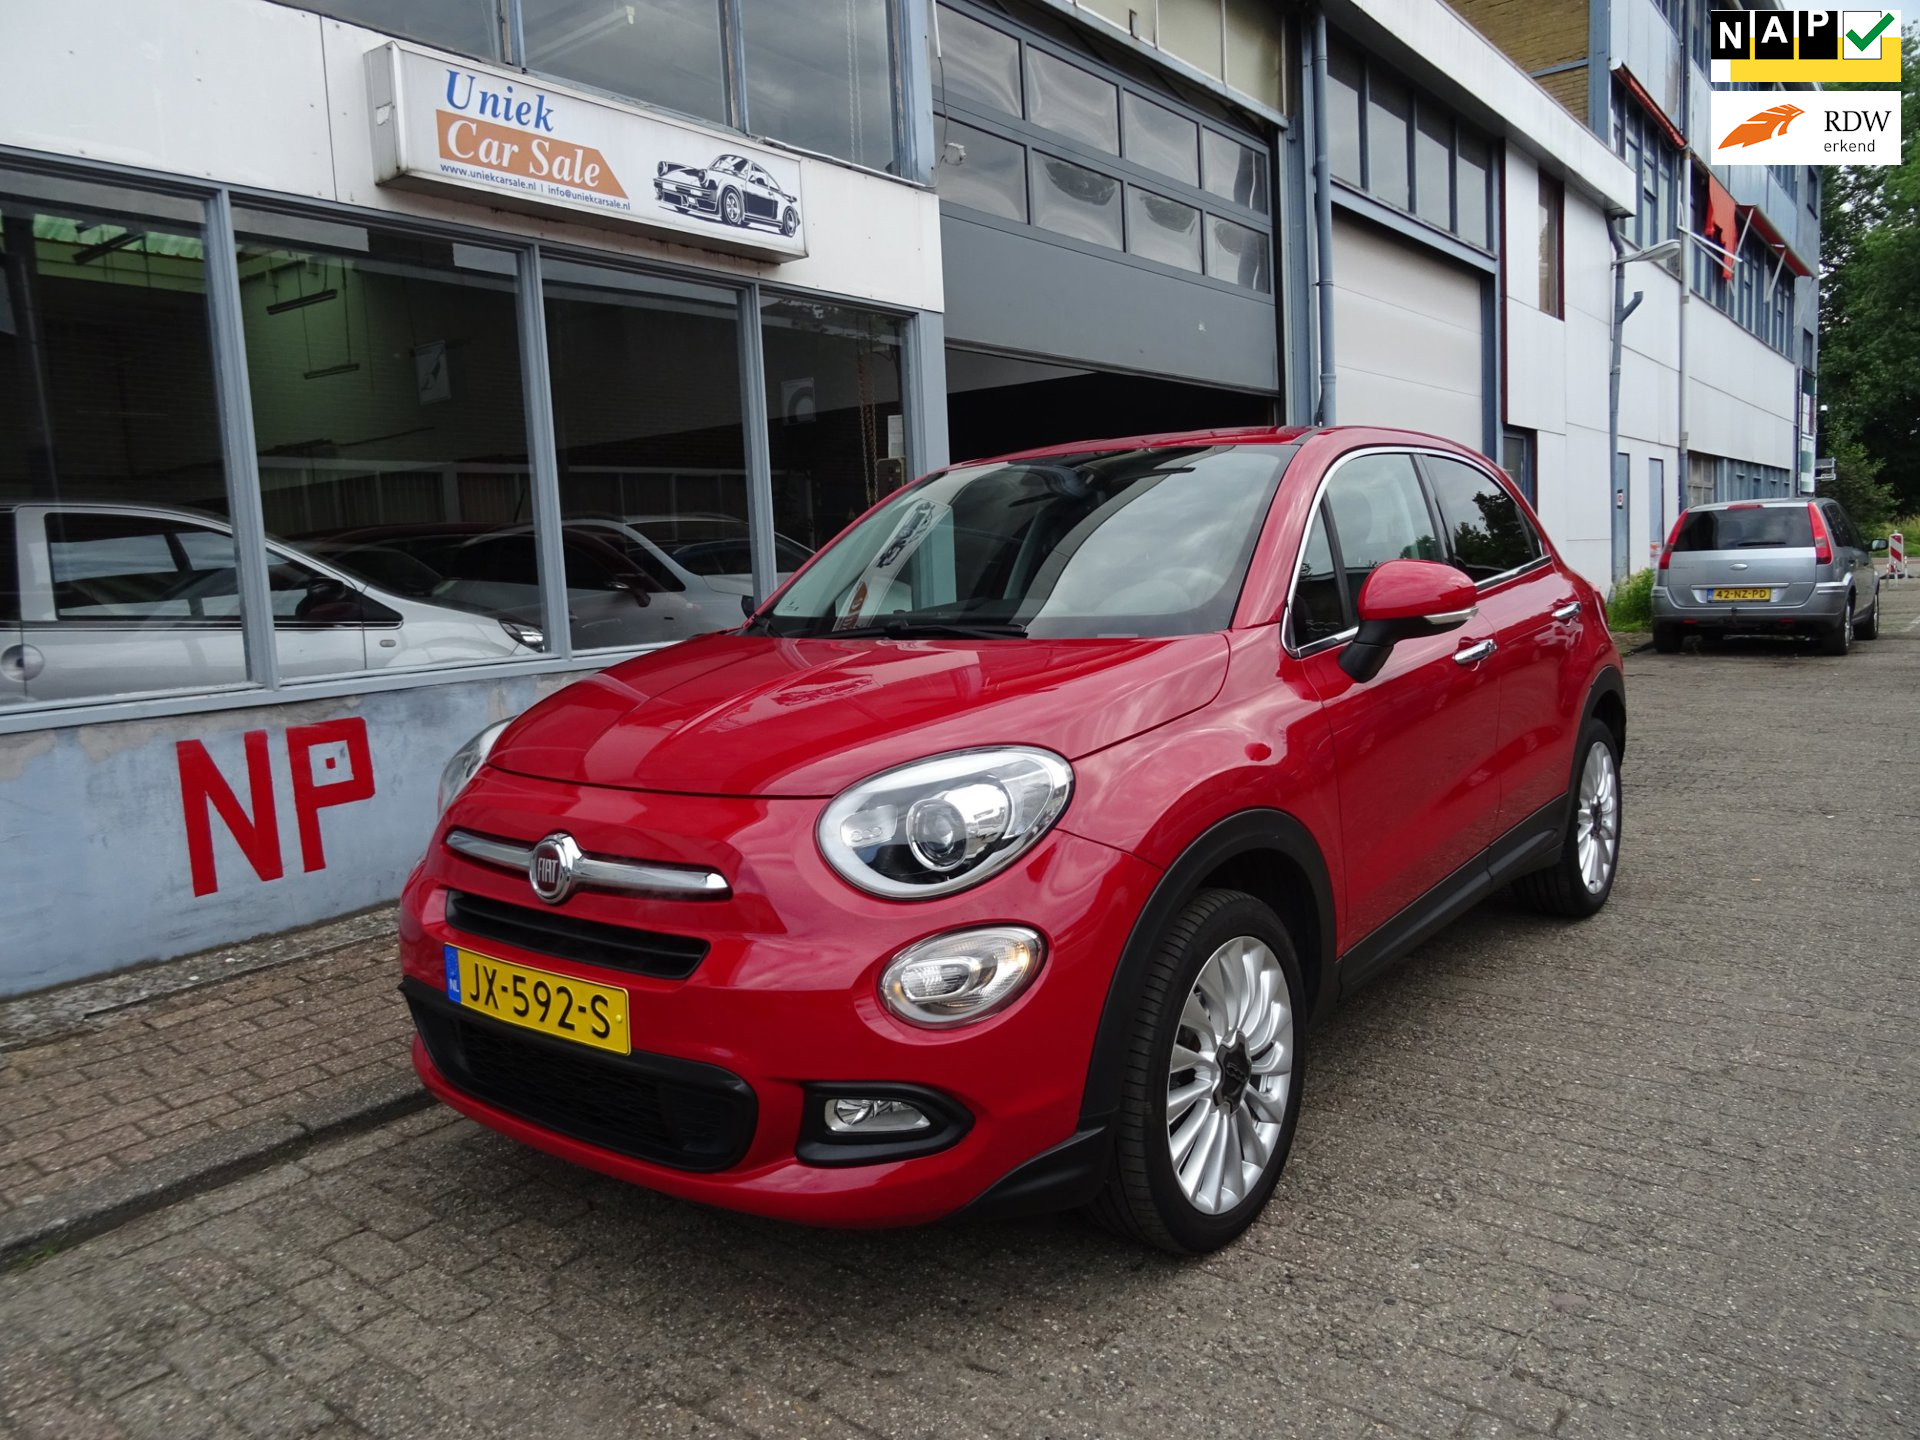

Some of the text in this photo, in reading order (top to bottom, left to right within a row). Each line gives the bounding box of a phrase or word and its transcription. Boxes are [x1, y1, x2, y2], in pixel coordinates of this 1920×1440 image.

[446, 69, 554, 132] Uniek
[447, 119, 600, 187] Car Sale
[440, 162, 537, 191] www.uniekcarsale.nl
[548, 184, 631, 211] info@uniekcarsale.nl
[1716, 589, 1767, 599] 42-NZ-PD
[176, 716, 376, 897] NP
[537, 857, 559, 884] FIAT
[449, 962, 611, 1040] NL JX-592-S
